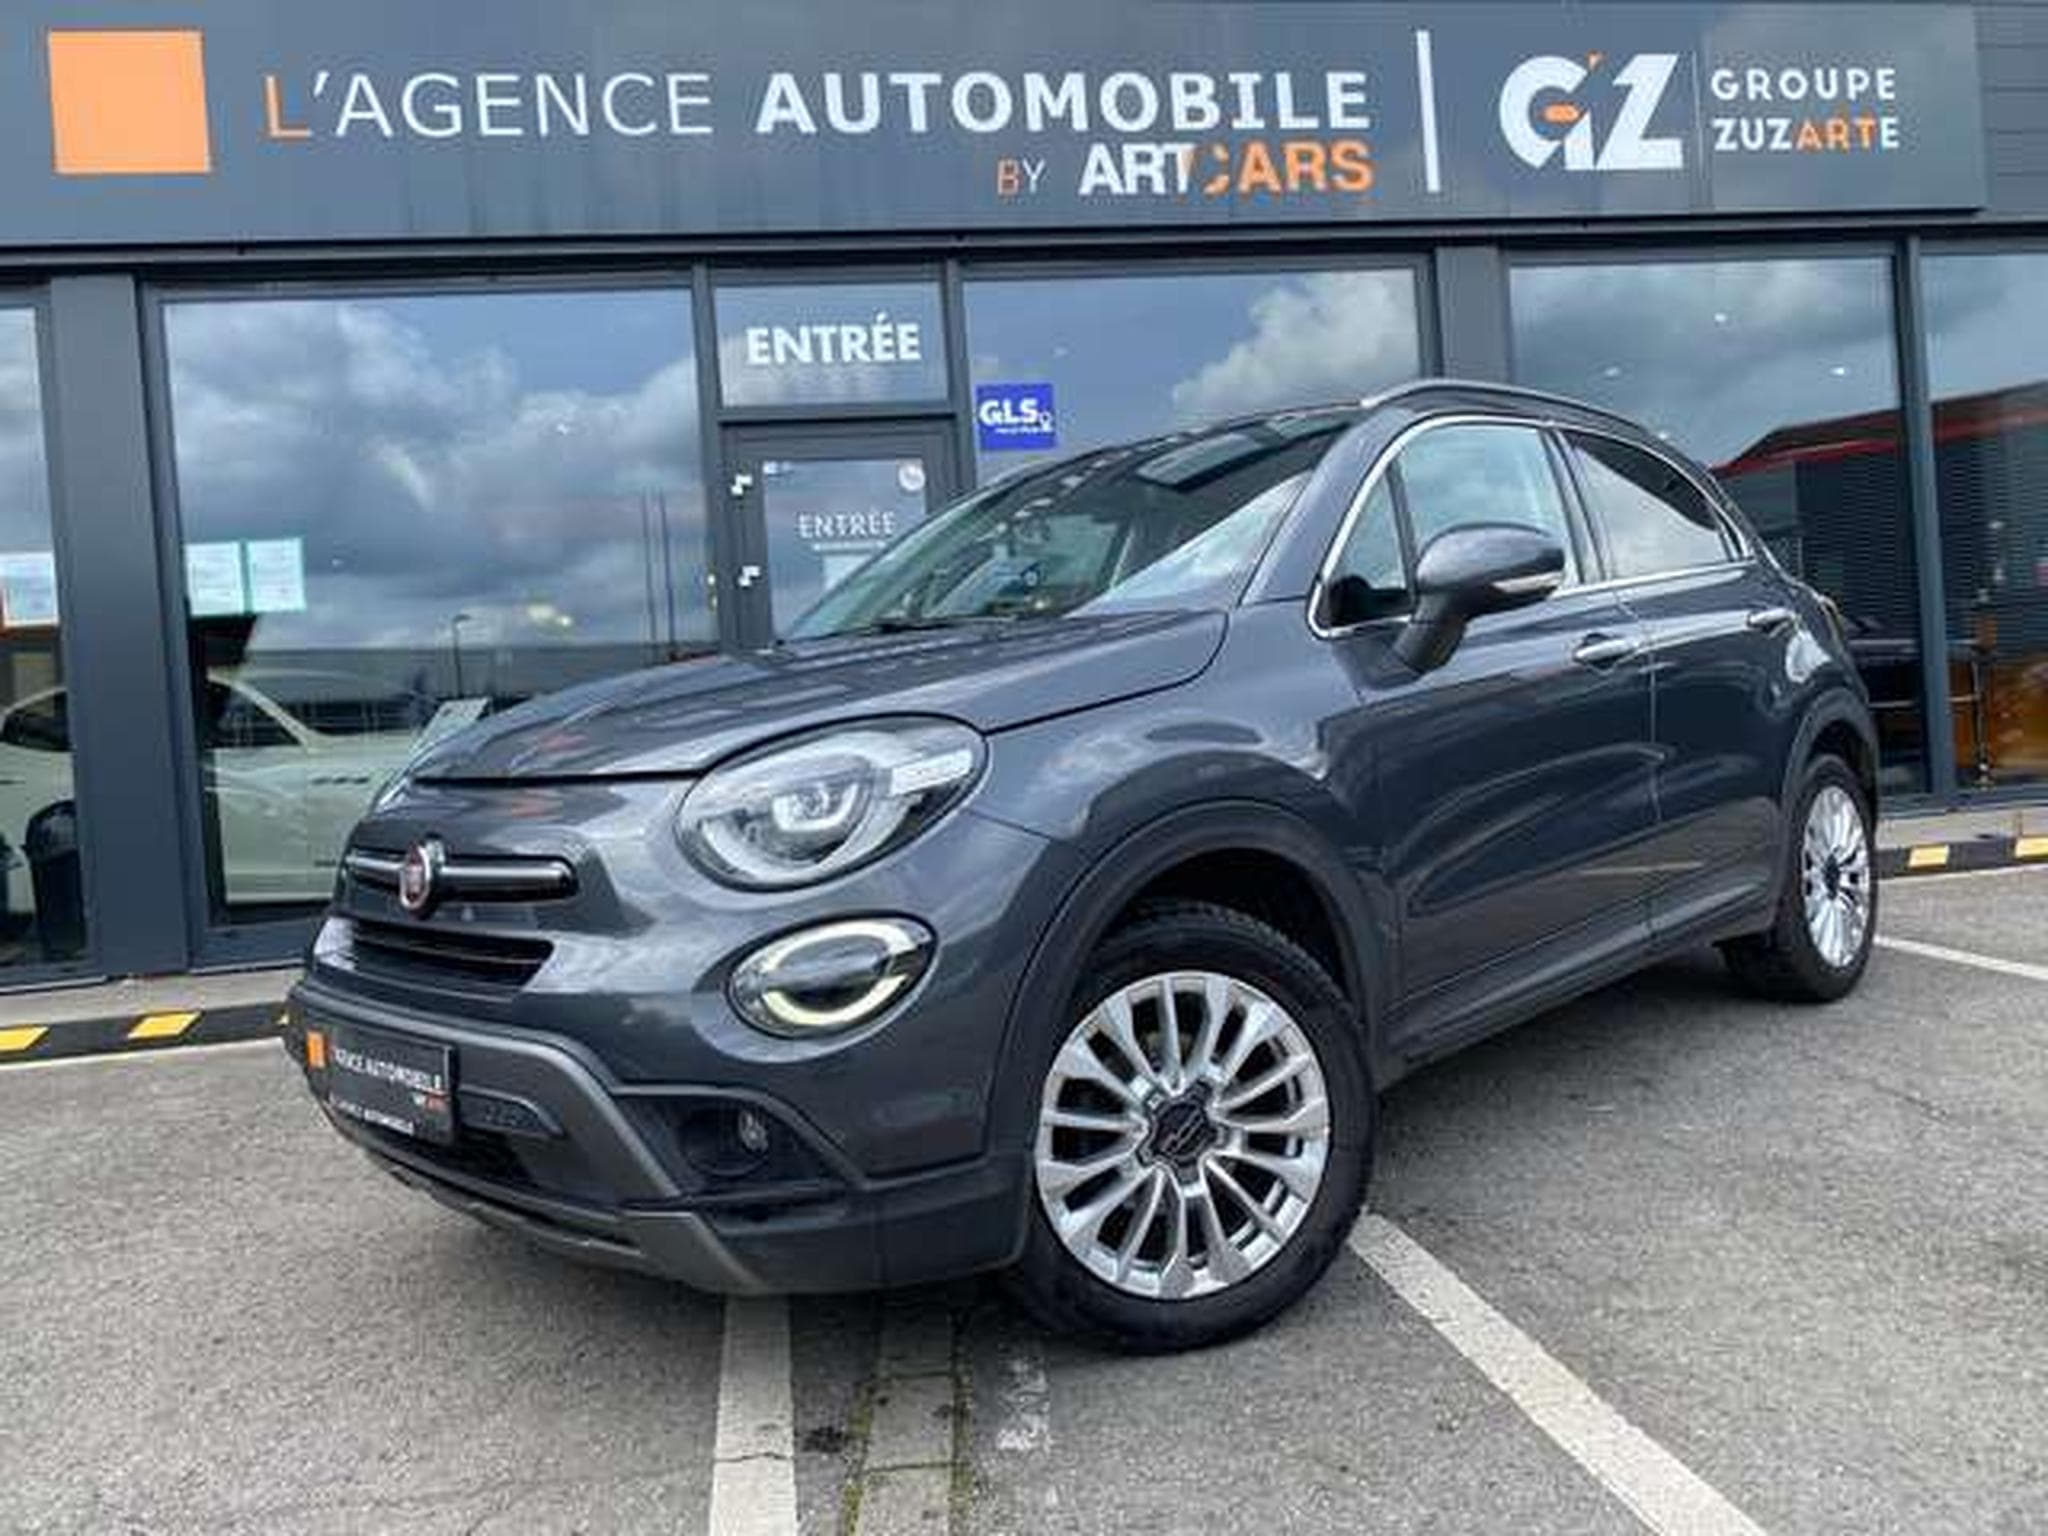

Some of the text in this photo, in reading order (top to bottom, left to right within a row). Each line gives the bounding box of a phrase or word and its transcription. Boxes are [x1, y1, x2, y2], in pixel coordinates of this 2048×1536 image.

[1710, 66, 1896, 102] GROUPE
[264, 71, 1371, 138] L'AGENCE AUTOMOBILE
[1713, 115, 1900, 153] ZUZARTE
[997, 157, 1046, 195] BY
[747, 312, 922, 366] ENTRÉE
[979, 397, 1038, 426] GLS
